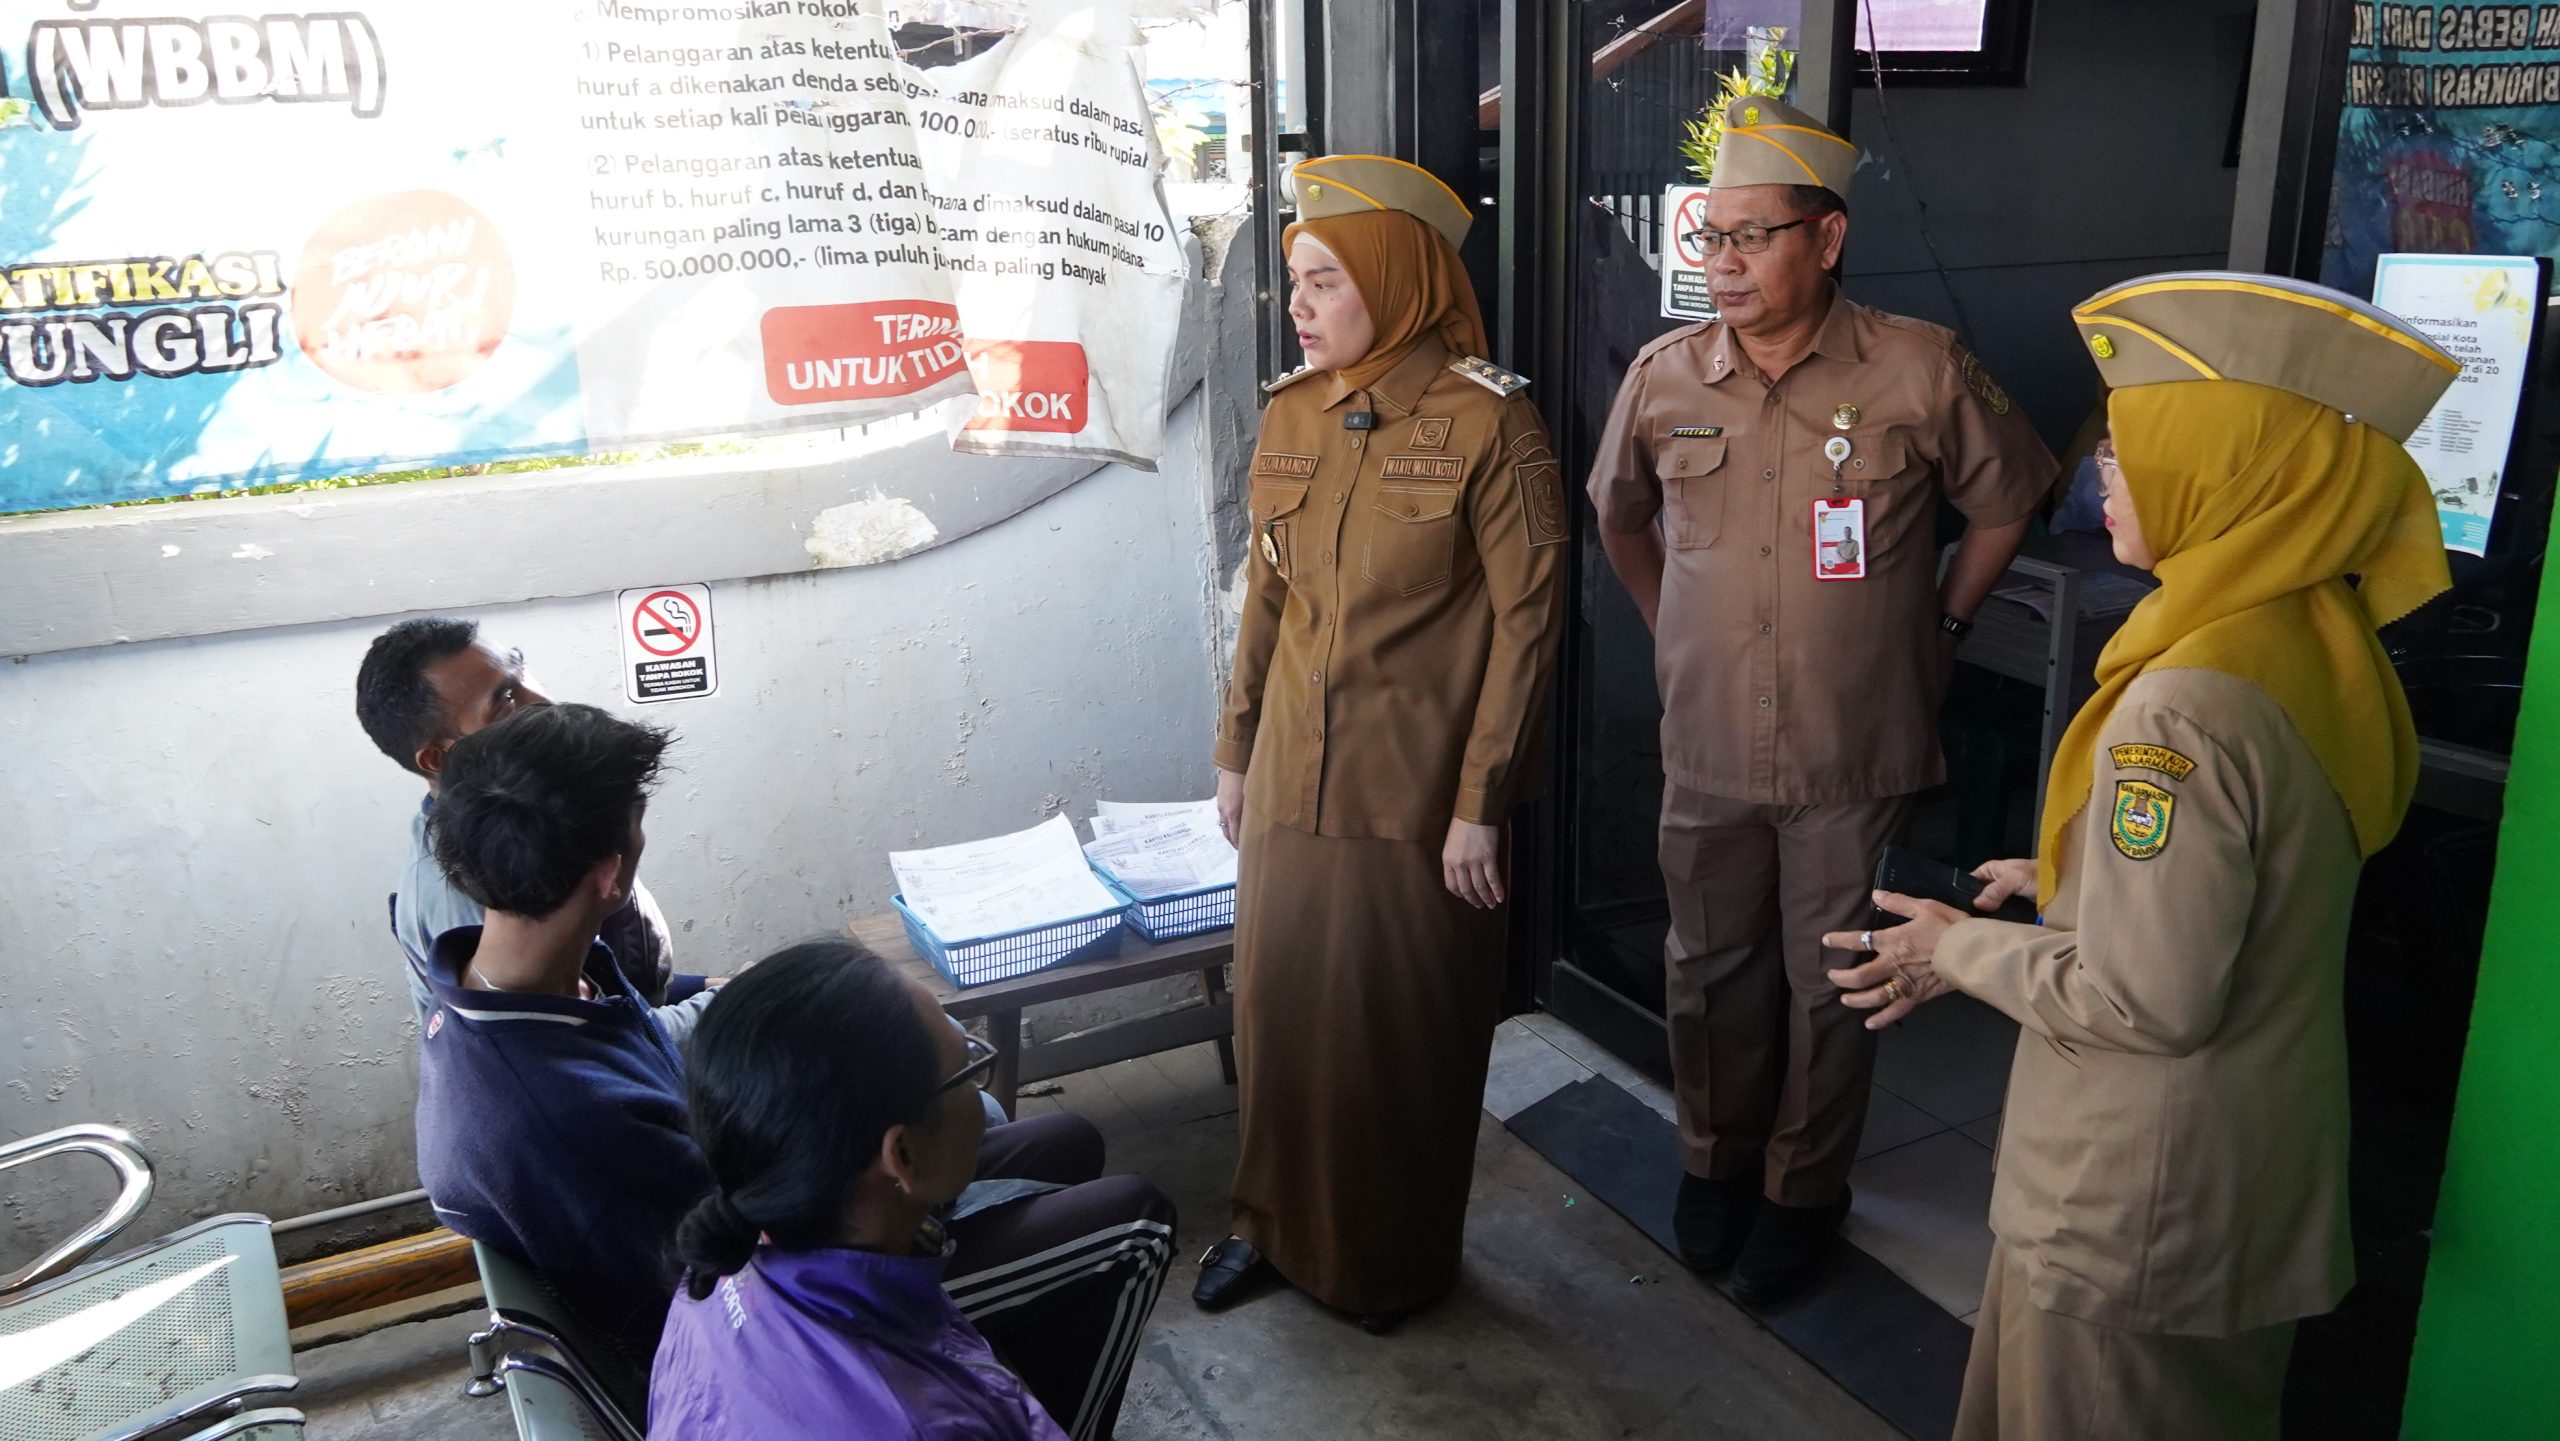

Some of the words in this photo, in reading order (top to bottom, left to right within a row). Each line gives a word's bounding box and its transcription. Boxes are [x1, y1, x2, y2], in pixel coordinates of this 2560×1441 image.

[598, 0, 790, 25] Mempromosikan
[799, 0, 859, 17] rokok
[607, 42, 753, 66] Pelanggaran
[761, 40, 806, 60] atas
[27, 13, 387, 131] (WBBM)
[576, 75, 640, 96] huruf
[650, 82, 662, 95] a
[669, 73, 785, 96] dikenakan
[792, 68, 859, 92] denda
[1070, 98, 1110, 127] dalam
[581, 111, 646, 131] untuk
[654, 108, 723, 131] setiap
[730, 105, 768, 127] kali
[1084, 131, 1107, 155] ribu
[625, 153, 771, 178] Pelanggaran
[778, 146, 823, 168] atas
[590, 188, 654, 210] huruf
[690, 184, 752, 207] huruf
[786, 179, 844, 201] huruf
[879, 180, 917, 200] dan
[973, 193, 1069, 215] dimaksud
[1073, 199, 1112, 226] dalam
[1114, 213, 1140, 238] pasal
[1143, 221, 1164, 242] 10
[330, 216, 476, 288] BERANI
[595, 226, 705, 249] kurungan
[713, 217, 781, 244] paling
[788, 213, 844, 234] lama
[848, 213, 862, 234] 3
[869, 211, 922, 236] (tiga)
[986, 225, 1061, 248] dengan
[1066, 227, 1110, 257] hukum
[1111, 244, 1145, 268] pidana
[600, 261, 637, 285] Rp.
[644, 247, 806, 280] 50.000.000,-
[814, 245, 869, 268] (lima
[875, 243, 929, 267] puluh
[995, 256, 1054, 280] paling
[1061, 258, 1107, 286] banyak
[2453, 334, 2478, 344] Kota
[2455, 344, 2482, 354] telah
[787, 353, 908, 391] UNTUK
[2472, 365, 2483, 374] di
[2486, 366, 2500, 375] 20
[1385, 459, 1413, 475] WAKIL
[638, 672, 671, 681] TANPA
[671, 668, 704, 678] ROKOK
[645, 660, 697, 672] KAWASAN
